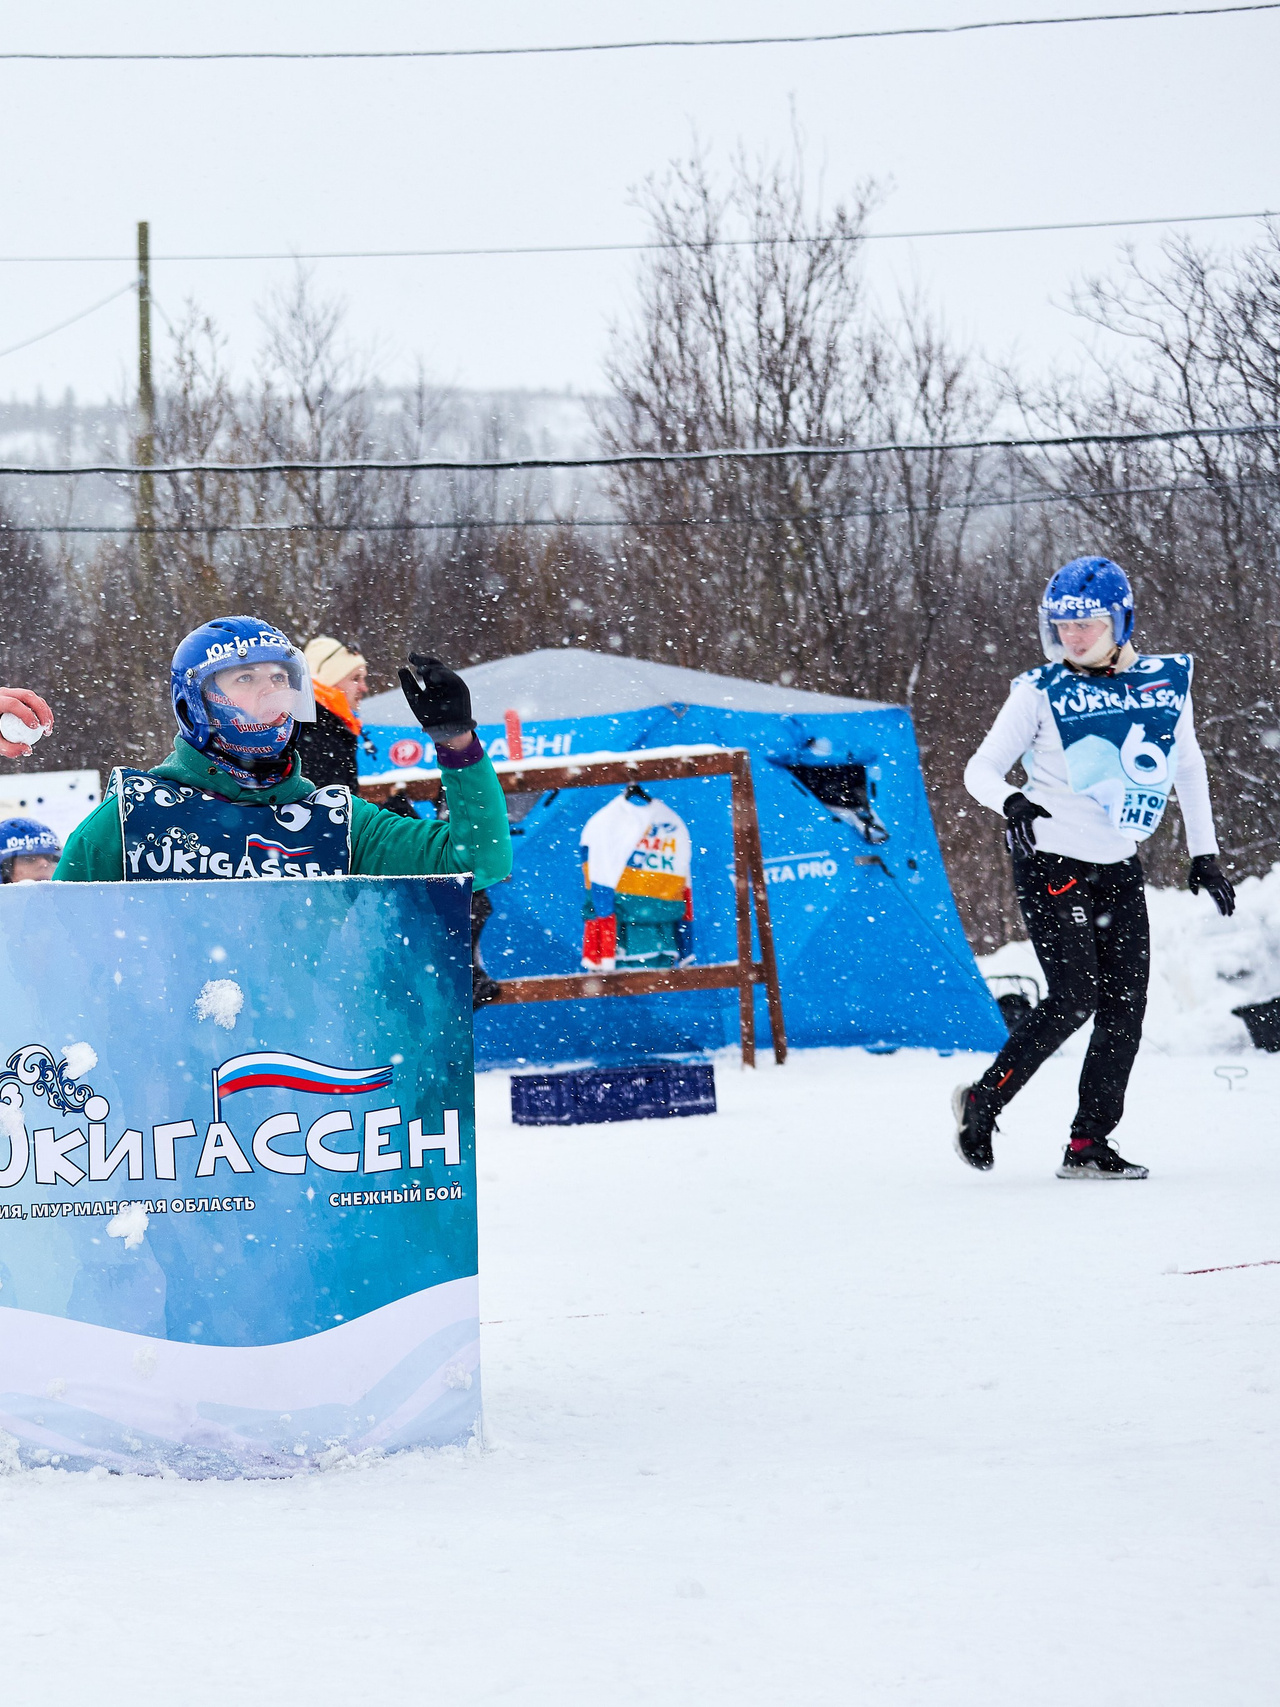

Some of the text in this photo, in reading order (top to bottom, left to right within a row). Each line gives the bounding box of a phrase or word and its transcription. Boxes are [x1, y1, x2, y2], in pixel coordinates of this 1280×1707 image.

[1120, 723, 1168, 786] 6
[797, 859, 838, 880] PRO
[328, 1181, 463, 1207] СНЕЖНЫЙ БОЙ
[31, 1198, 168, 1218] МУРМАНСАЯ
[170, 1196, 256, 1214] ОБЛАСТЬ
